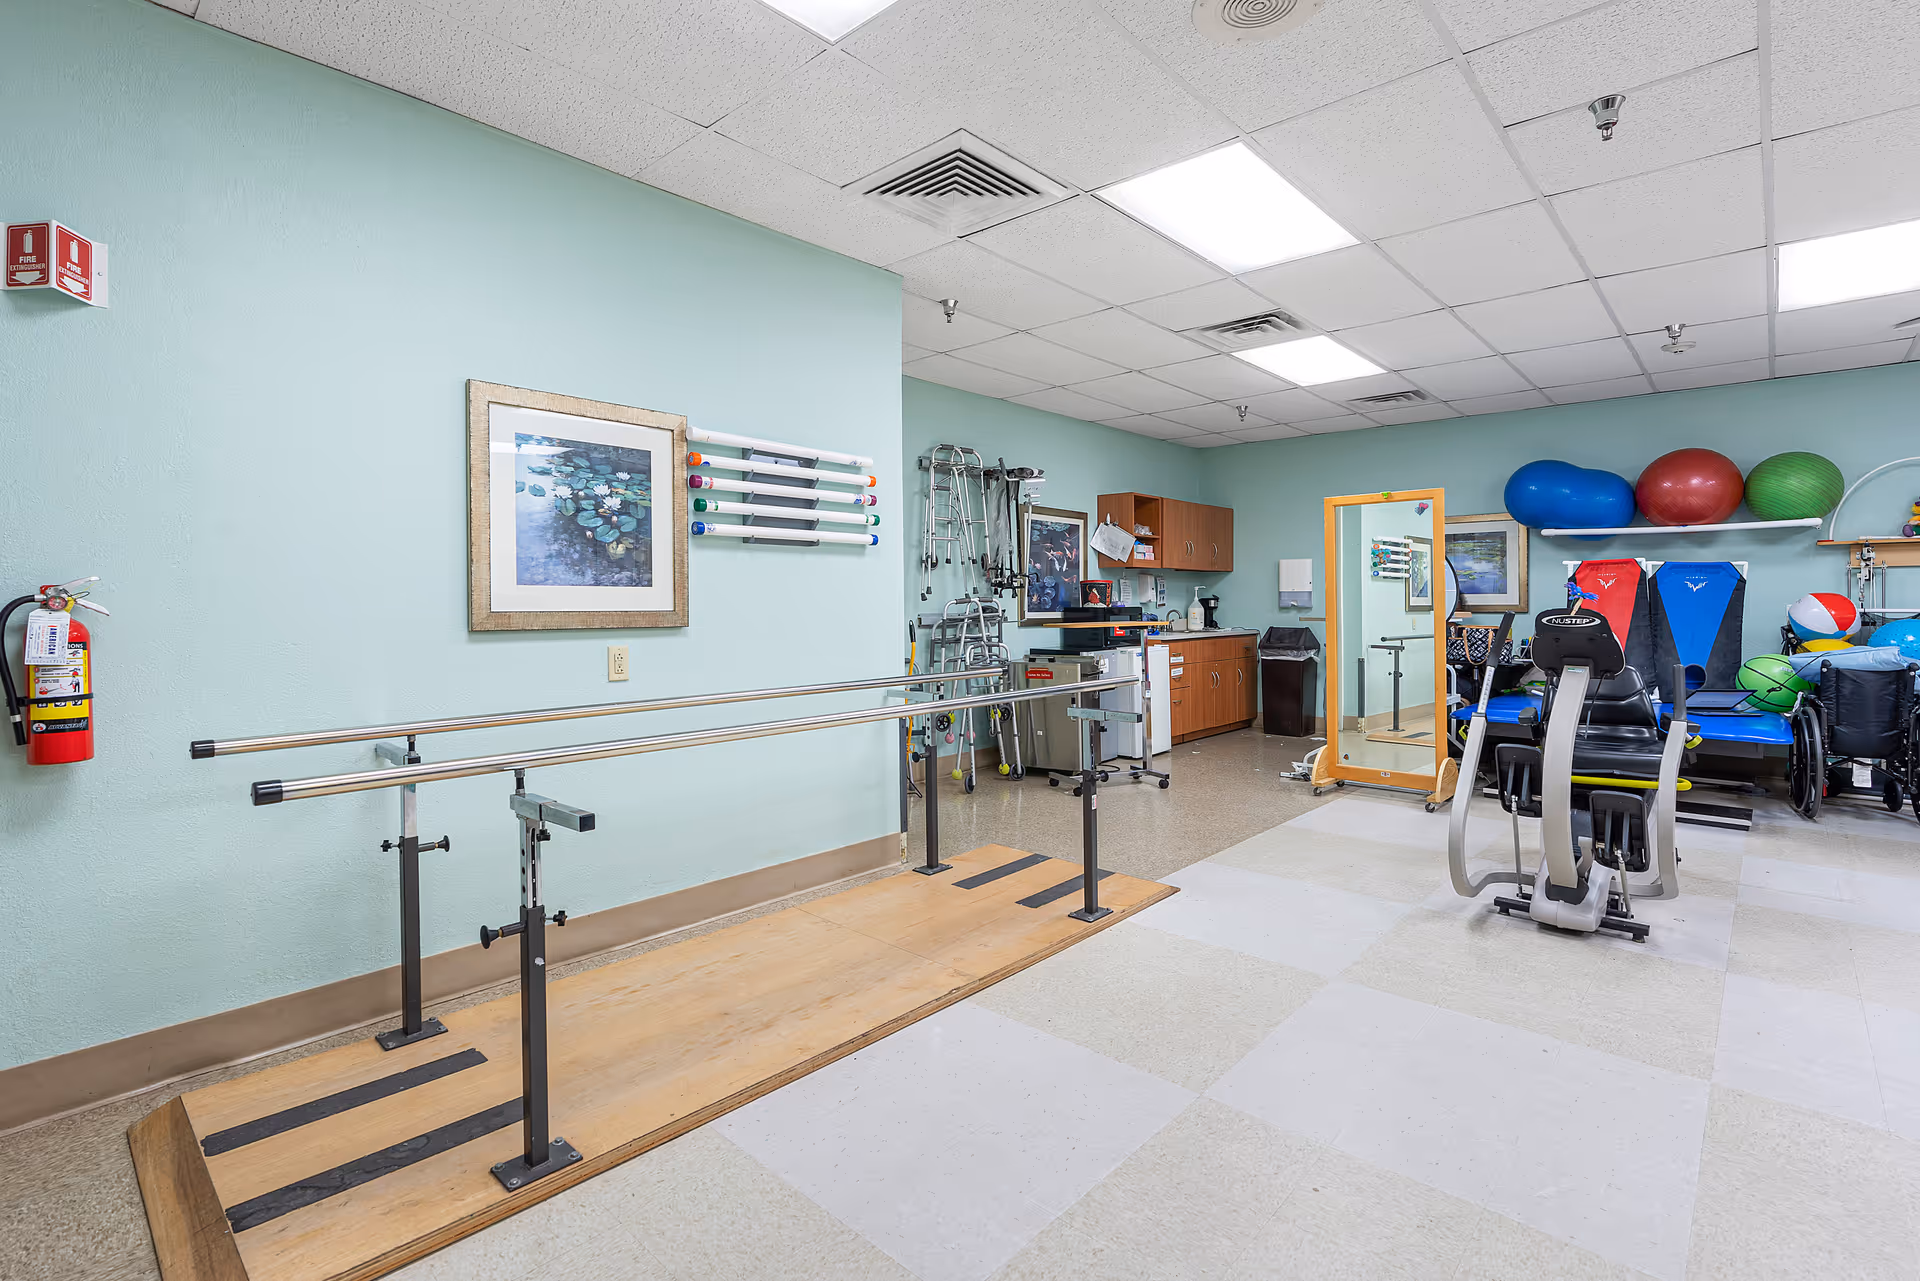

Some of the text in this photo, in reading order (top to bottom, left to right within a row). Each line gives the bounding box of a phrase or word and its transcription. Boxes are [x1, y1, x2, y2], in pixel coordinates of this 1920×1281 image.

[10, 263, 45, 271] EXTINGUISHER
[67, 262, 81, 275] FIRE
[59, 266, 88, 285] EXTINGUISHER
[48, 628, 57, 655] AMERICAN
